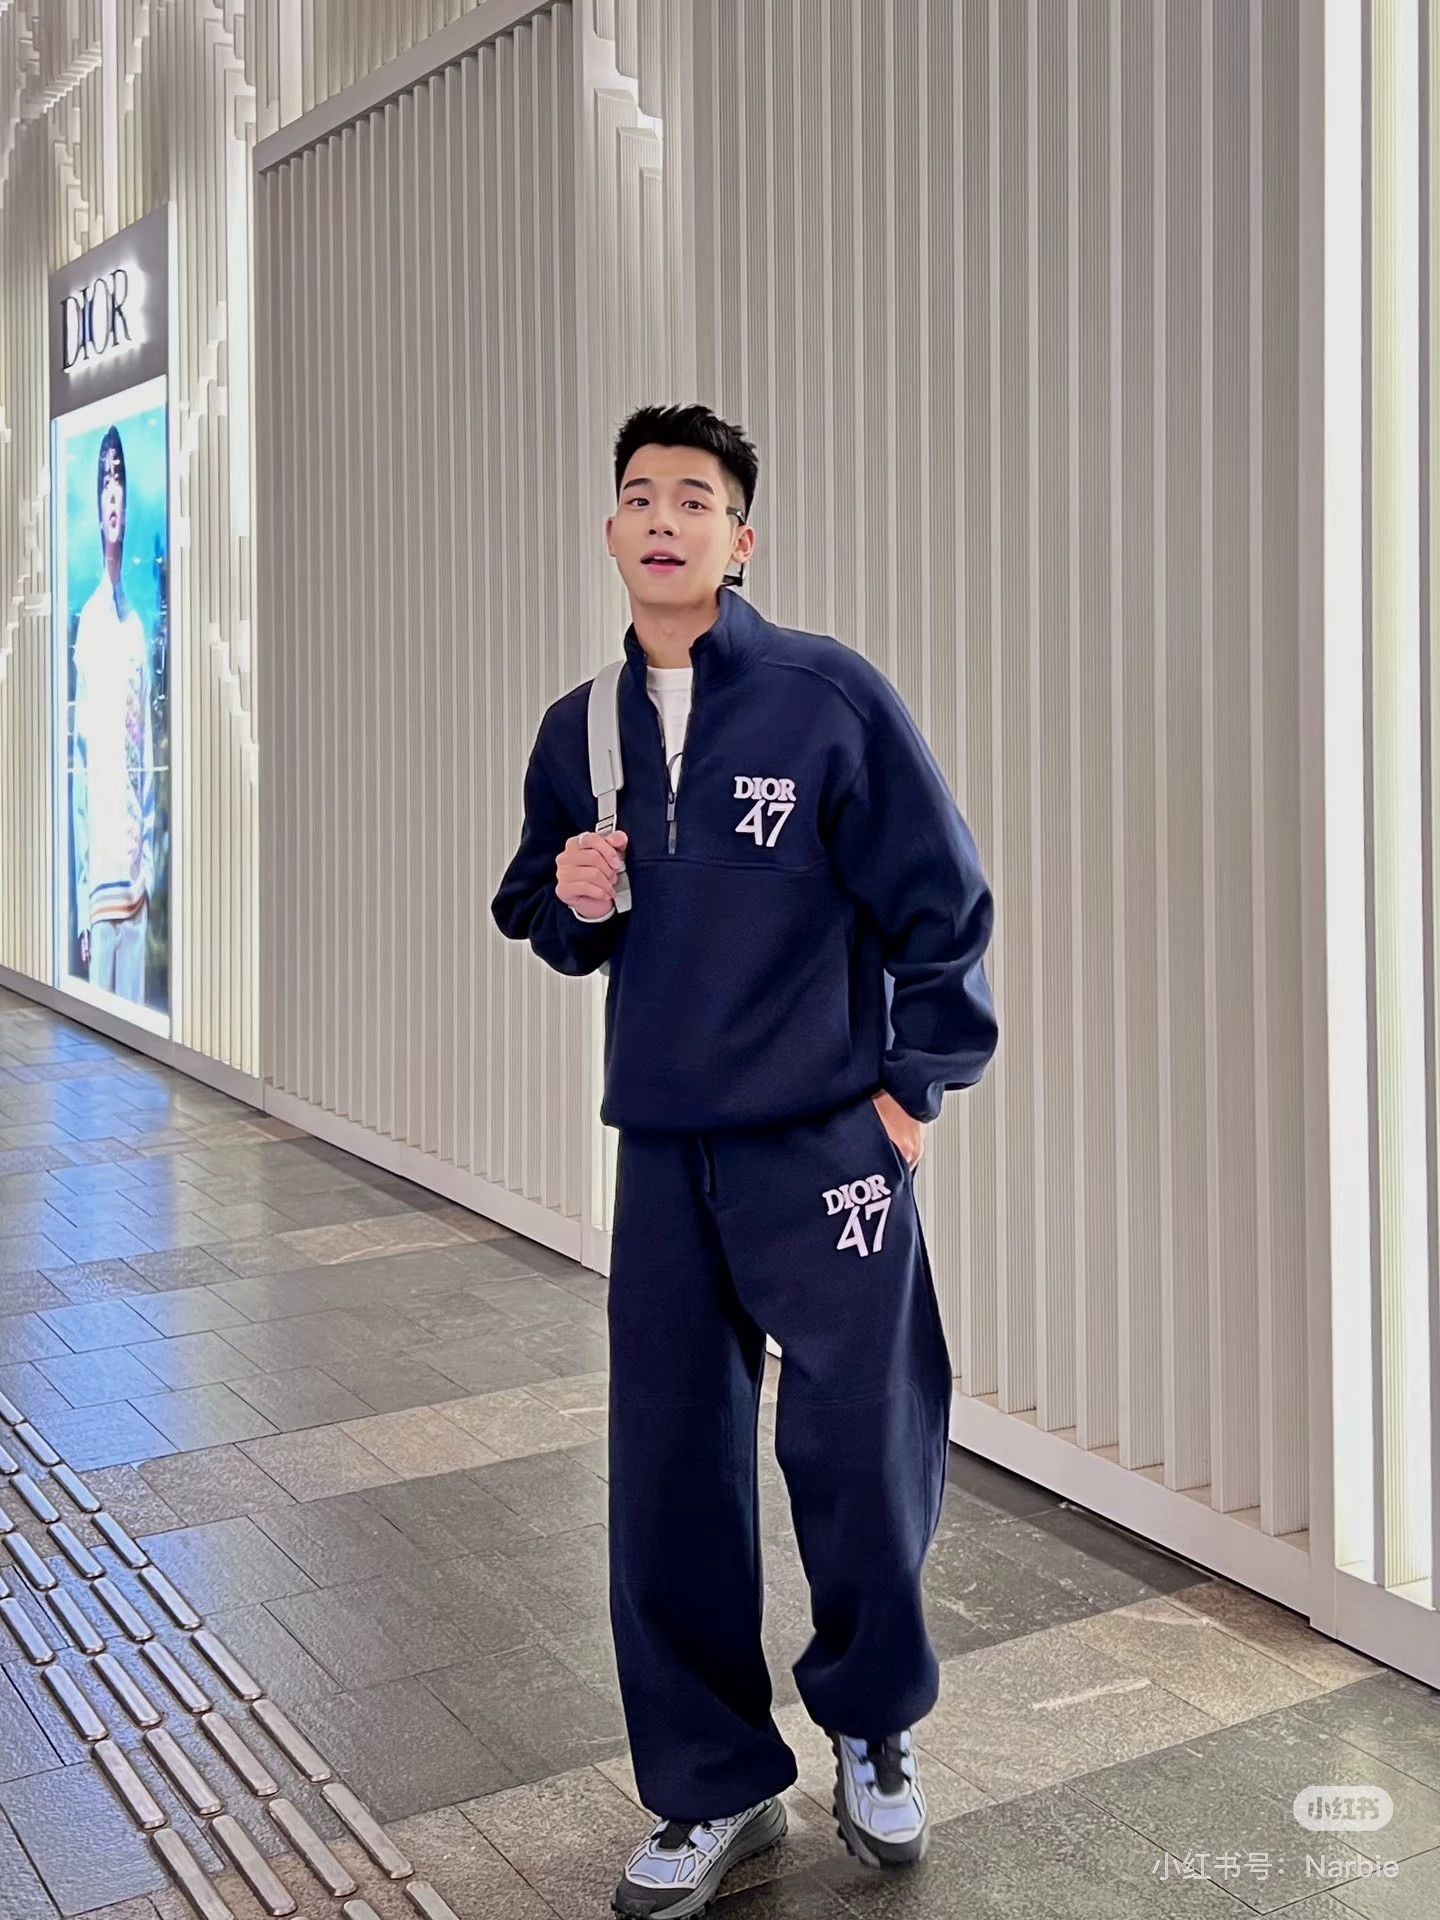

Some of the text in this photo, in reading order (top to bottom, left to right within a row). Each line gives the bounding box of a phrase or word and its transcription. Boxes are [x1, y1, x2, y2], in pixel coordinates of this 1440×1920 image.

[60, 268, 133, 373] DIOR
[733, 775, 797, 802] DIOR
[735, 799, 795, 848] 47
[821, 1173, 892, 1216] DIOR
[836, 1196, 892, 1258] 47
